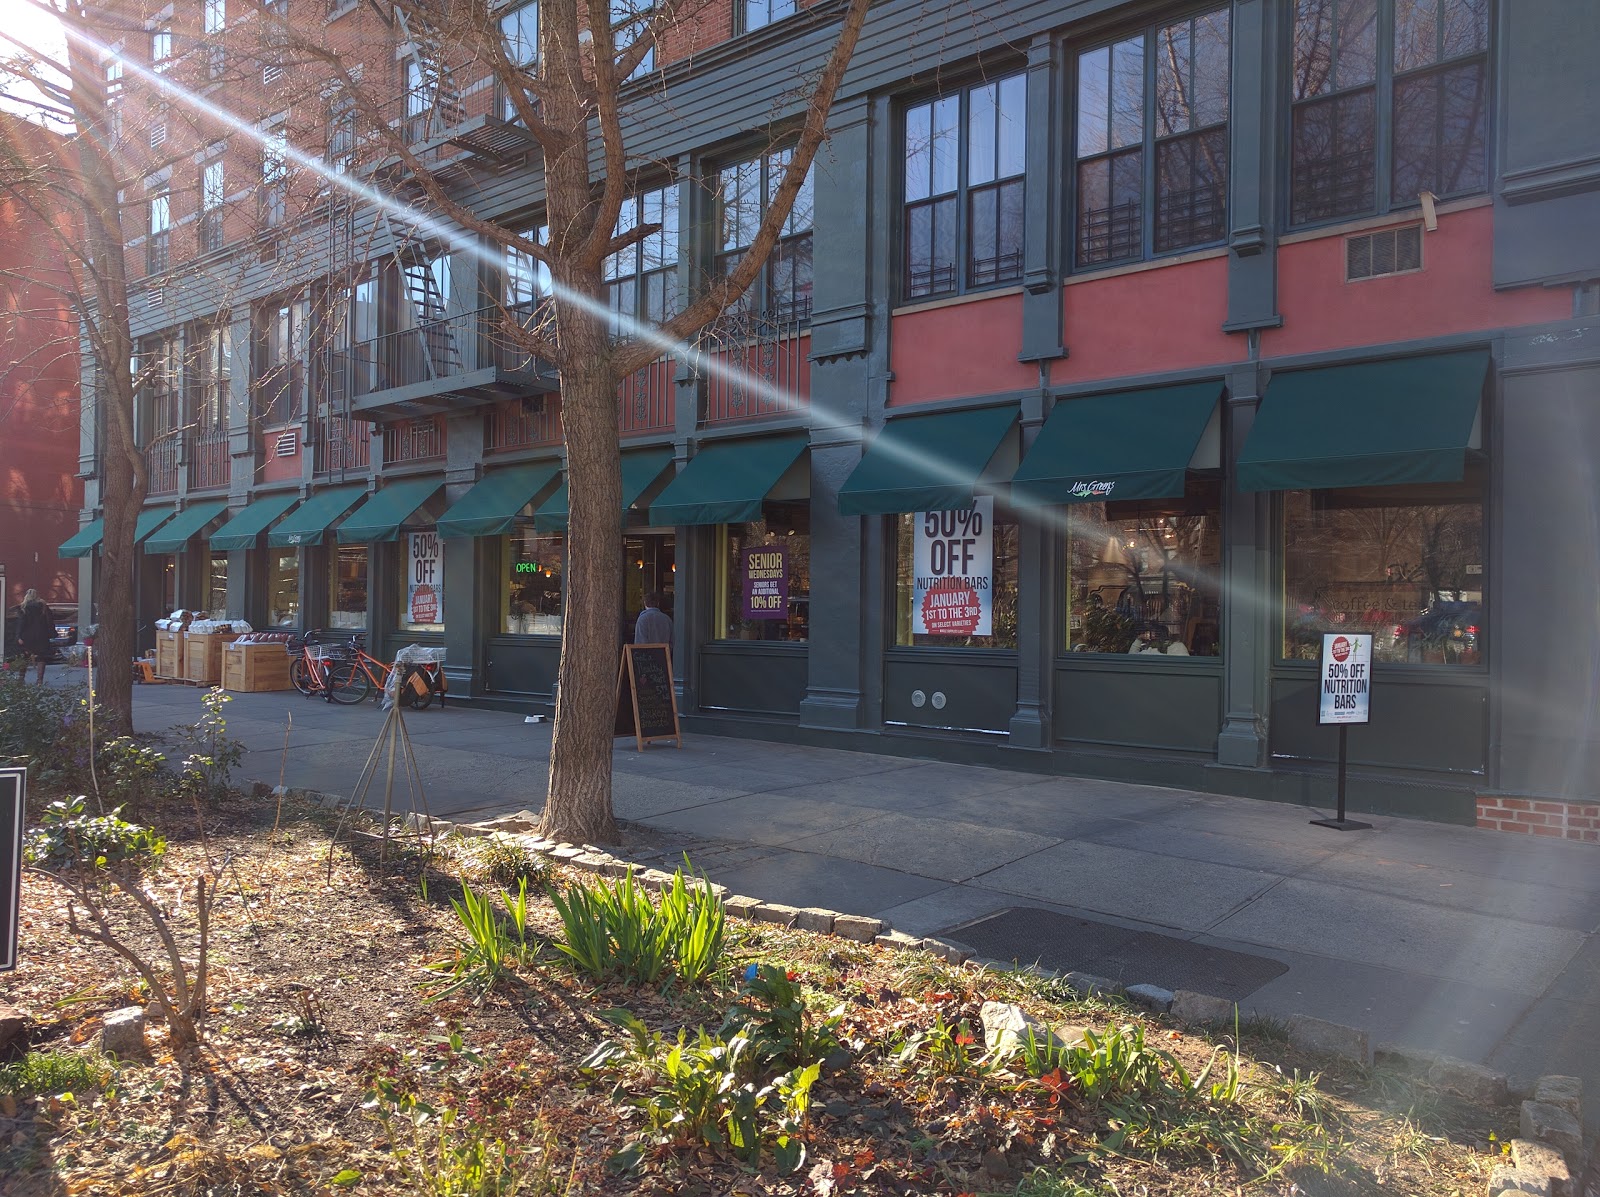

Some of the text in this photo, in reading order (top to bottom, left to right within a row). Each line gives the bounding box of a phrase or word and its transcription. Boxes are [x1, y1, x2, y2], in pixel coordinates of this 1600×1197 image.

[924, 500, 982, 538] 50%
[413, 534, 438, 559] 50%
[748, 553, 783, 570] SENIOR
[931, 539, 976, 575] OFF
[415, 559, 436, 583] OFF
[516, 563, 536, 573] OPEN
[748, 569, 783, 579] WEDNESDAYS
[916, 576, 989, 590] NUTRITION BARS
[750, 595, 783, 609] 10% OFF
[929, 591, 971, 608] JANUARY
[925, 606, 978, 621] 1ST TO THE 3RD
[1328, 663, 1366, 678] 50% OFF
[1324, 679, 1367, 694] NUTRITION
[1334, 694, 1357, 709] BARS
